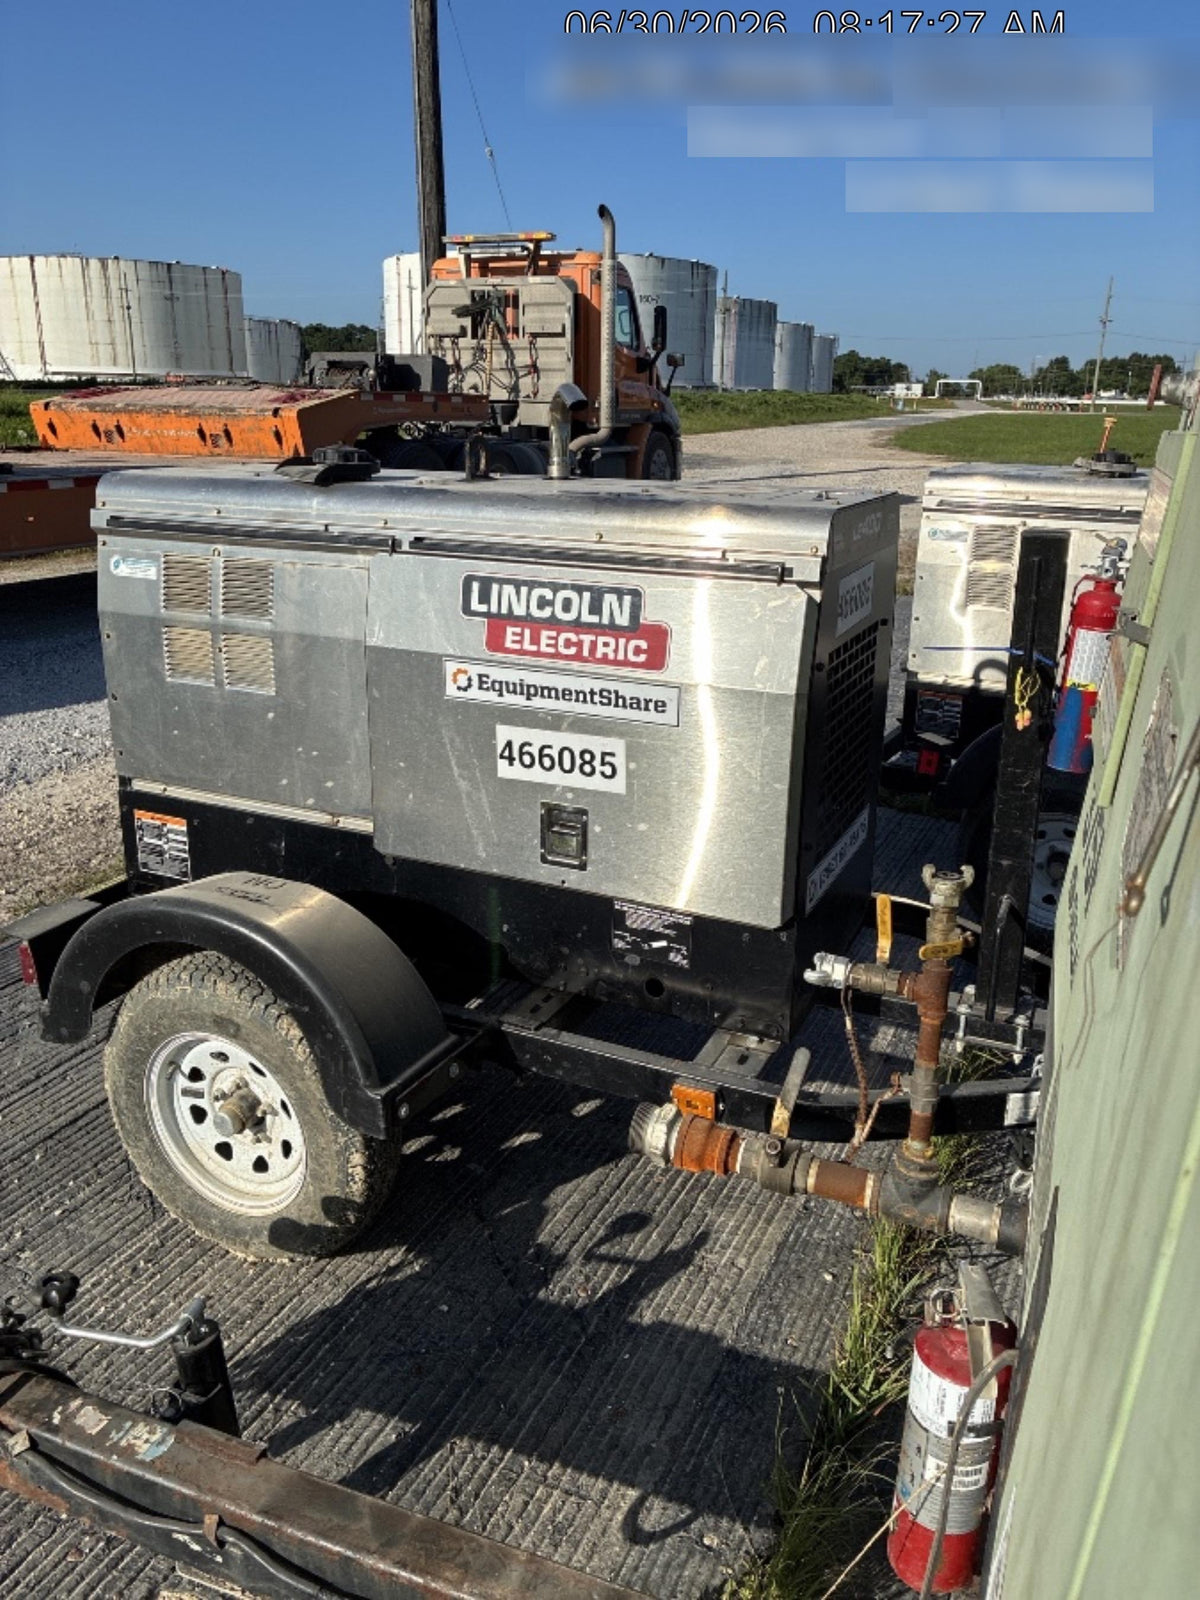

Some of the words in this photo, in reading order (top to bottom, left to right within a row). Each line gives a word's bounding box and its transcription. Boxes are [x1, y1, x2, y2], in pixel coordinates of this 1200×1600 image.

[470, 581, 633, 627] LINCOLN
[504, 625, 649, 663] ELECTRIC
[477, 673, 668, 715] EquipmentShare
[498, 738, 618, 780] 466085
